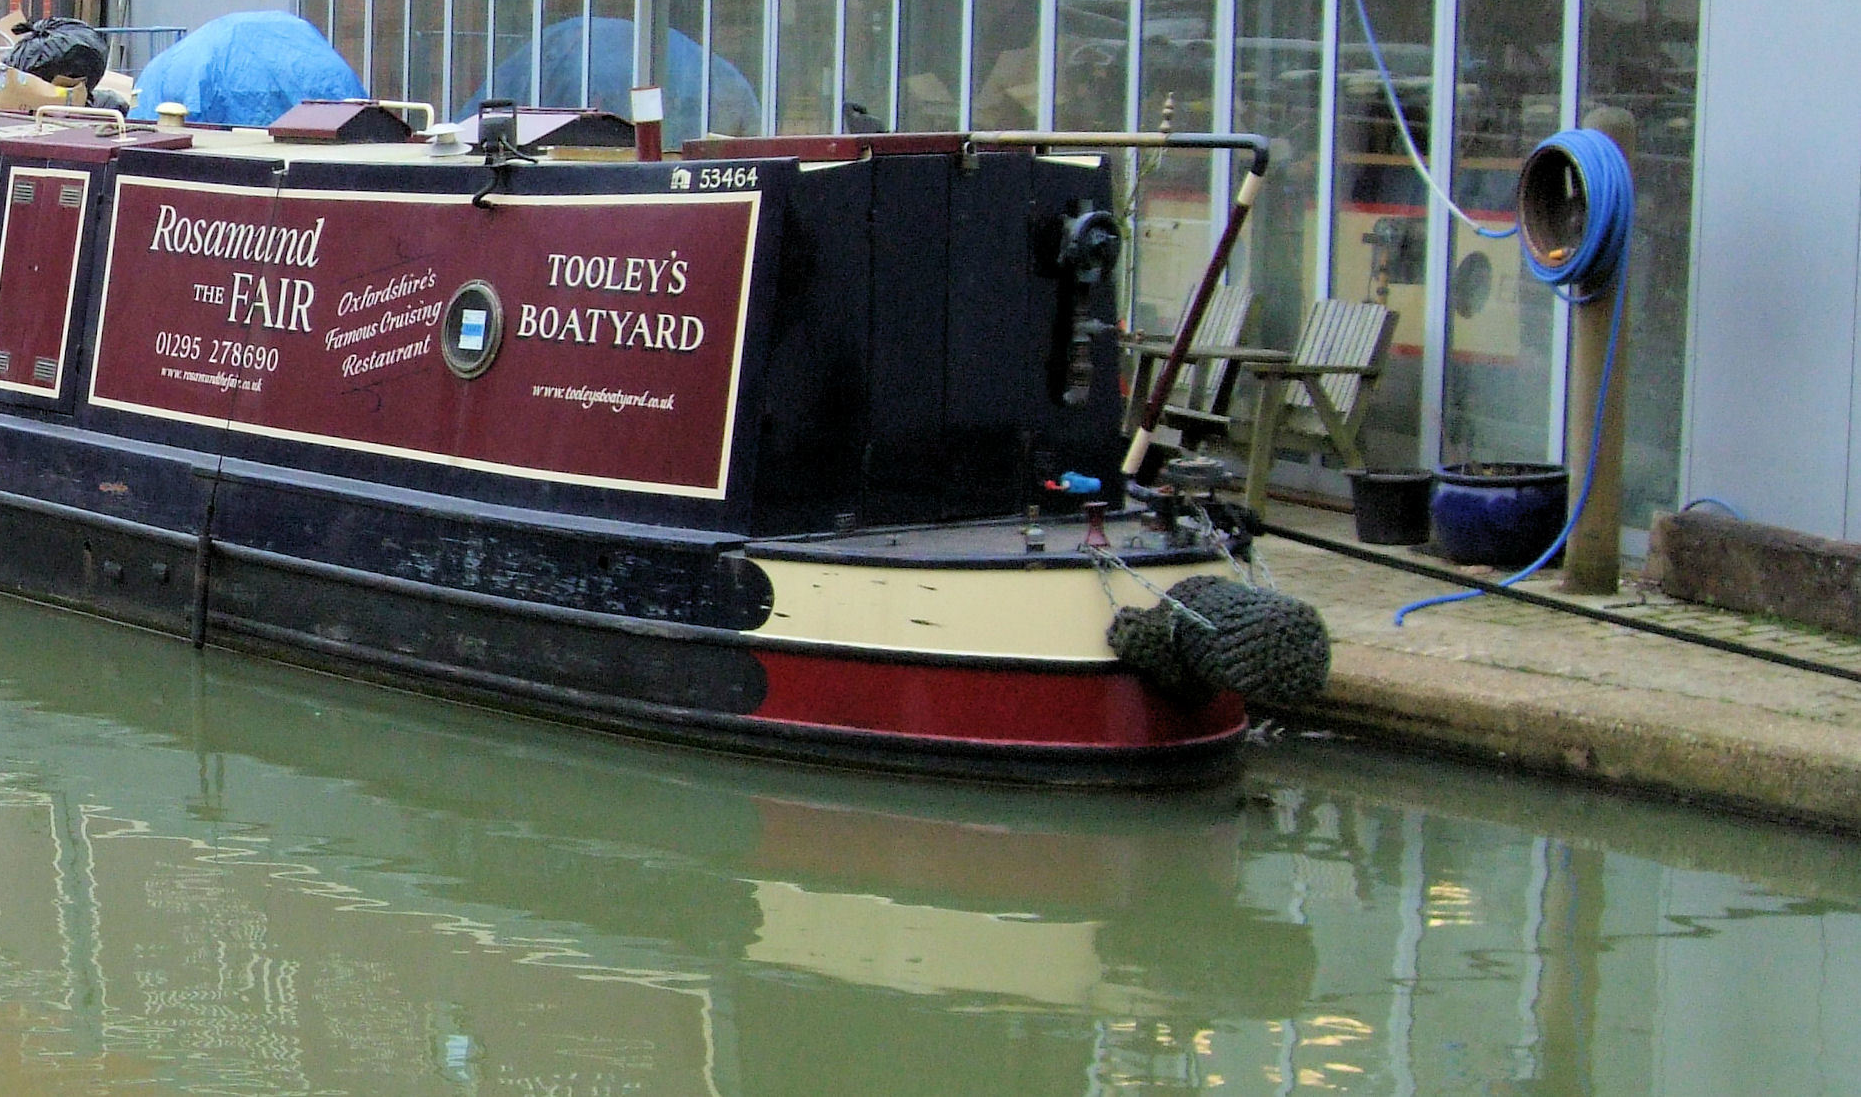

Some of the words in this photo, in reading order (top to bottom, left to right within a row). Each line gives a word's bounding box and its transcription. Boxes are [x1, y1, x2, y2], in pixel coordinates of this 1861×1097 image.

[699, 166, 759, 189] 53464
[149, 204, 326, 268] Rosamund
[337, 267, 437, 317] Oxfordshire's
[547, 249, 689, 295] TOOLEY'S
[193, 283, 225, 305] THE
[227, 272, 315, 333] FAIR
[325, 322, 379, 351] Famous
[379, 300, 443, 334] Cruising
[155, 331, 203, 360] 01295
[208, 339, 279, 372] 278690
[516, 303, 705, 352] BOATYARD
[342, 333, 432, 378] Restaurant
